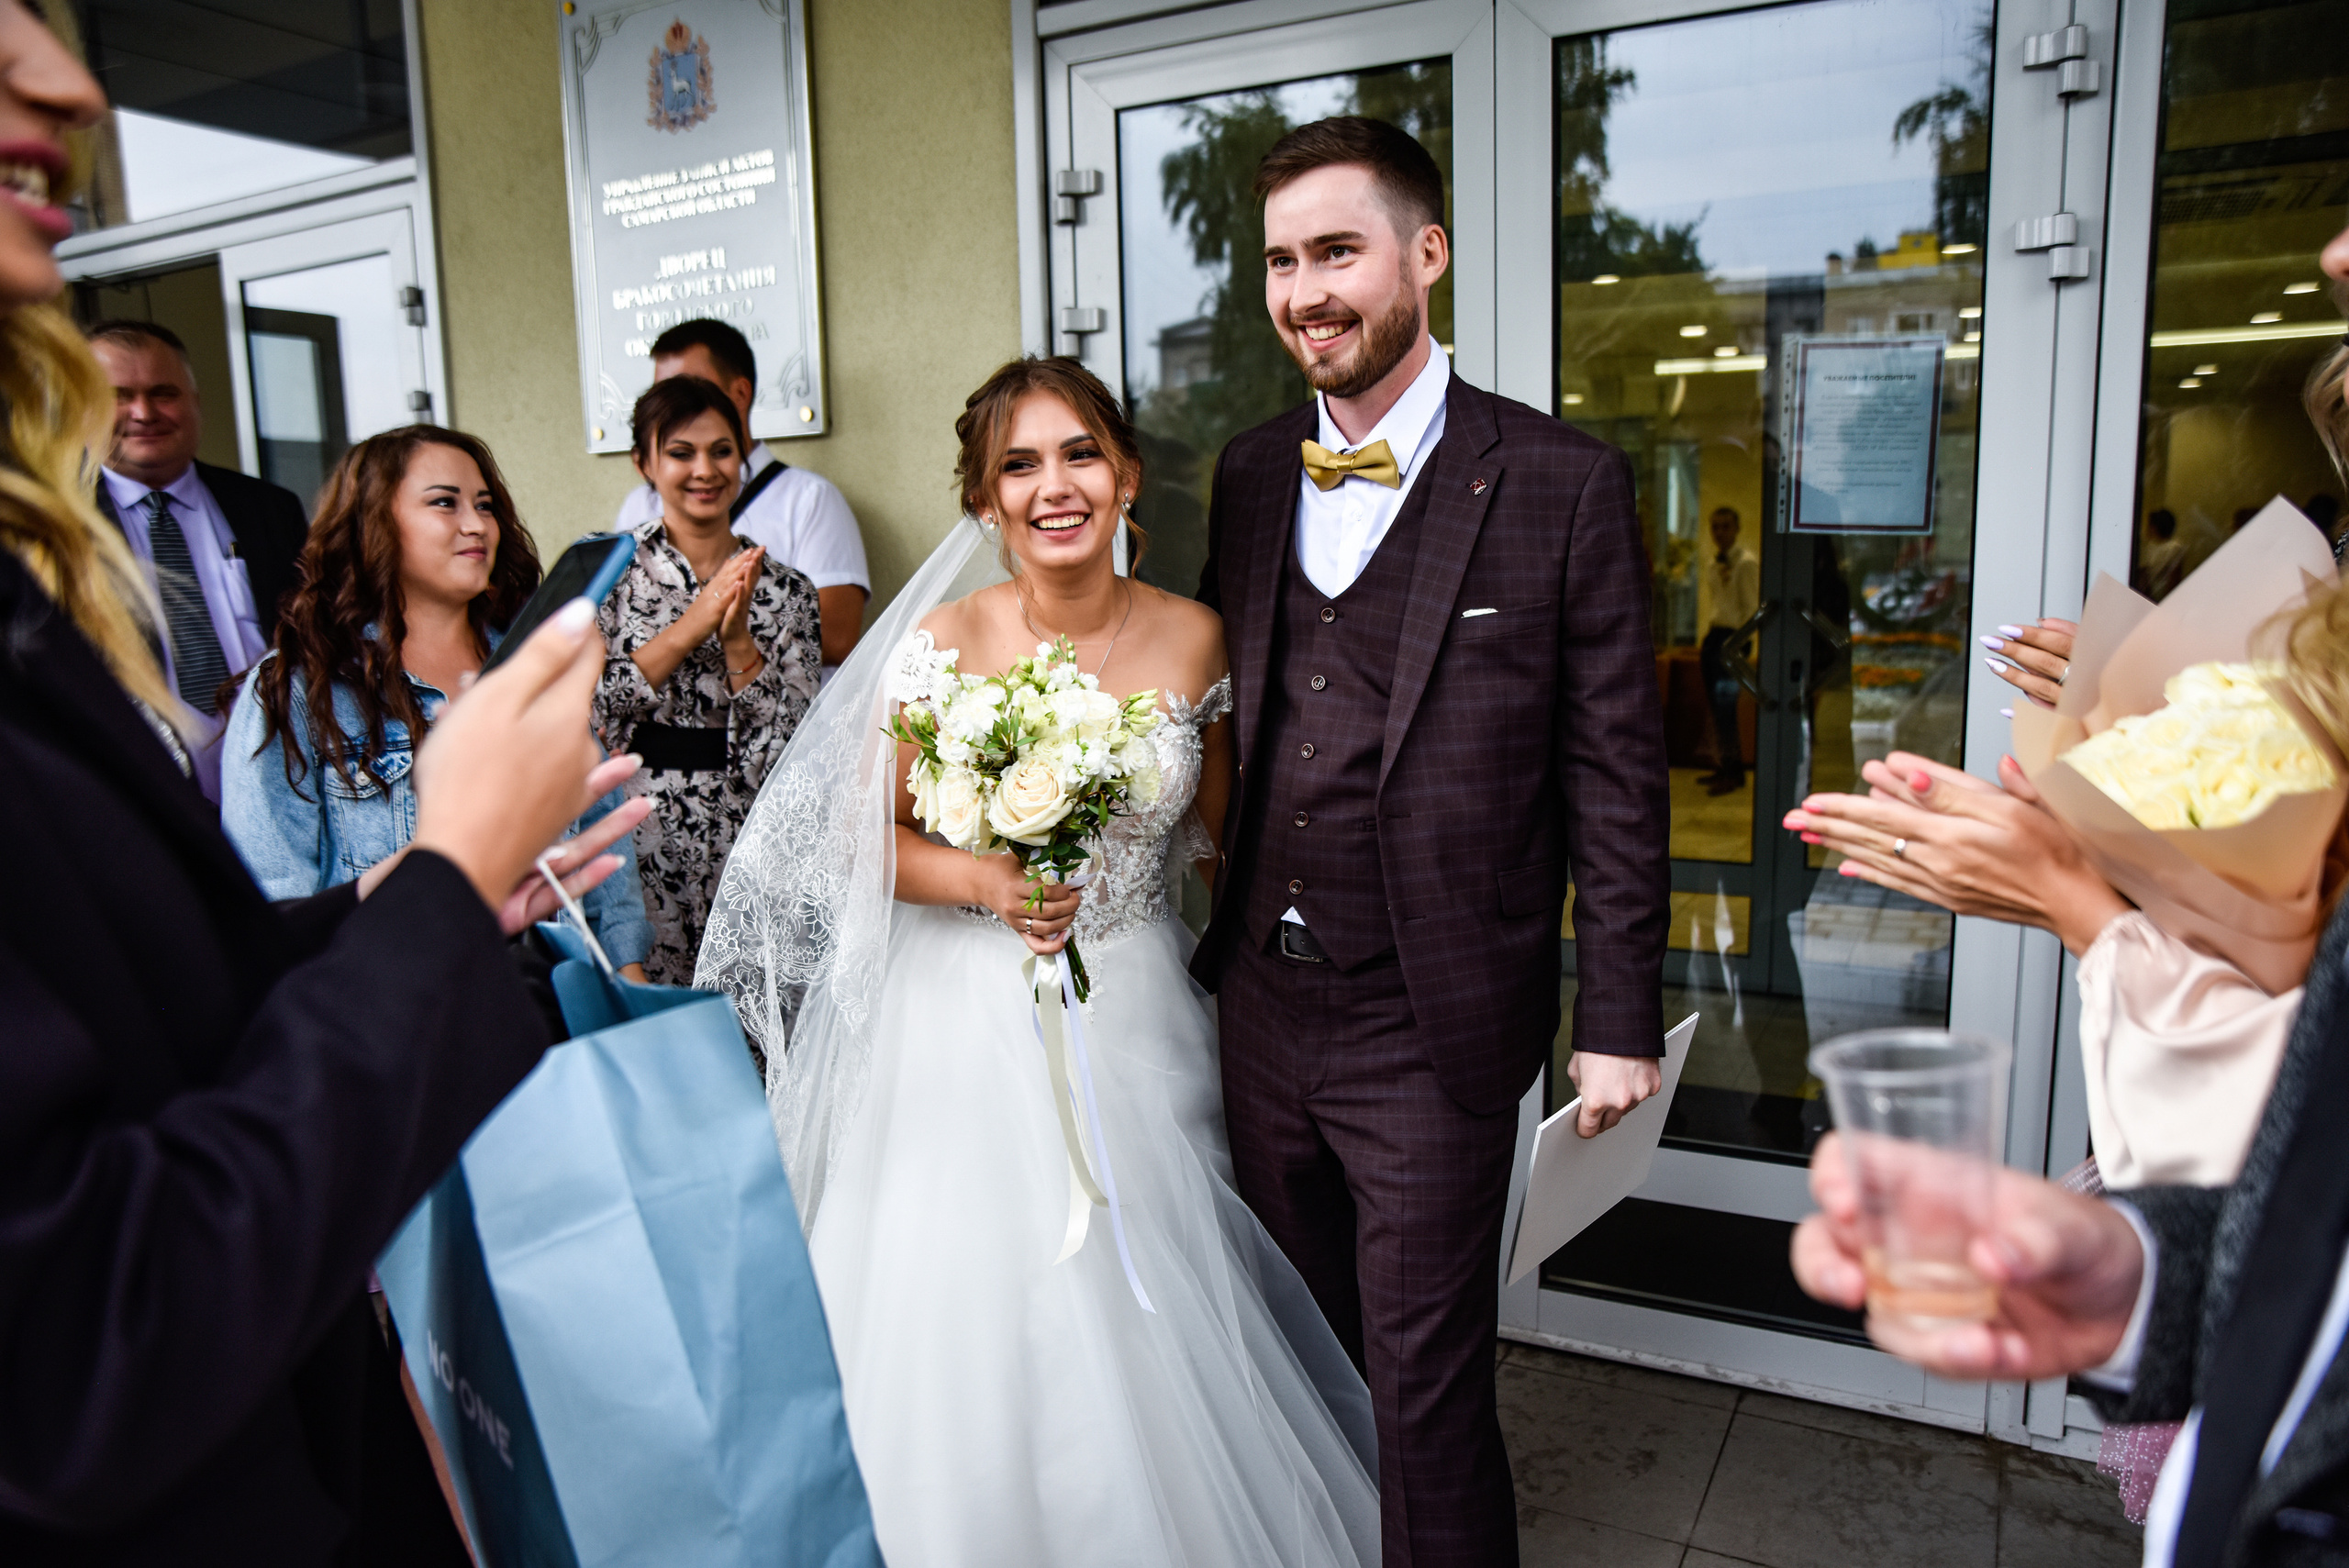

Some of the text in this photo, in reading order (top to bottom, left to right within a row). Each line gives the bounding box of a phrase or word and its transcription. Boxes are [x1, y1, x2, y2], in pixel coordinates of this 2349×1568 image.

[621, 187, 756, 228] САМАРСКОЙ ОБЛАСТИ
[653, 246, 727, 281] ДВОРЕЦ
[612, 264, 777, 310] БРАКОСОЧЕТАНИЯ
[1822, 374, 1868, 383] УВАЖАЕМЫЕ
[459, 1378, 514, 1471] ONE
